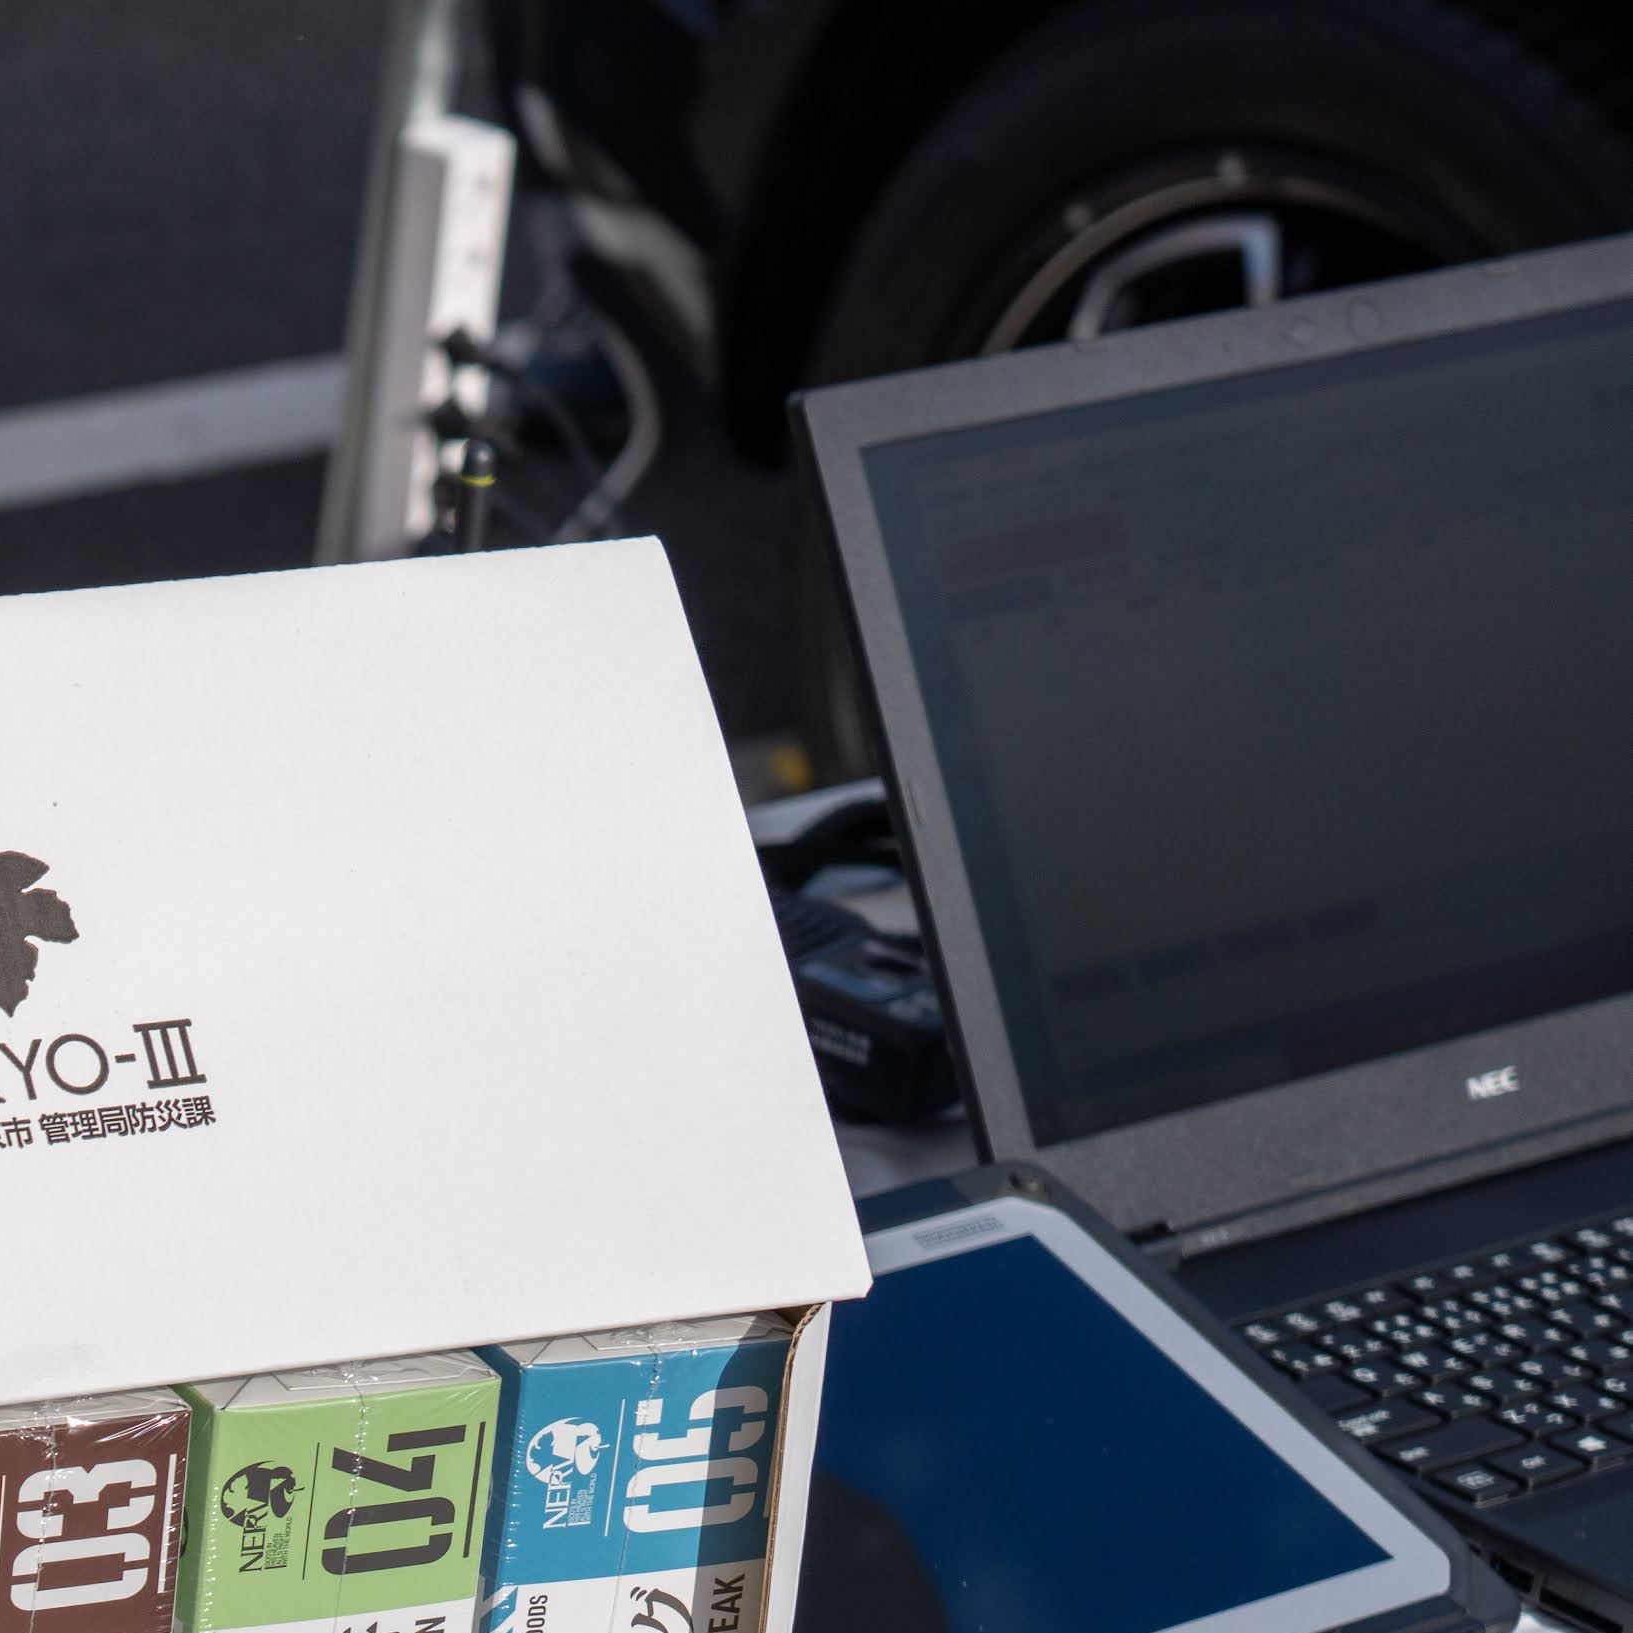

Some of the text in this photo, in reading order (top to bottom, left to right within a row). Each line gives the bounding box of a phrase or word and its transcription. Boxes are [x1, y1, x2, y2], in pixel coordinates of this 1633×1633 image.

[1467, 1066, 1521, 1101] NEC
[38, 1095, 216, 1146] 管理局防災課
[543, 1457, 574, 1529] NERV
[622, 1385, 768, 1533] 05
[10, 1458, 157, 1611] 03
[321, 1425, 466, 1575] 04
[239, 1502, 268, 1572] NERV
